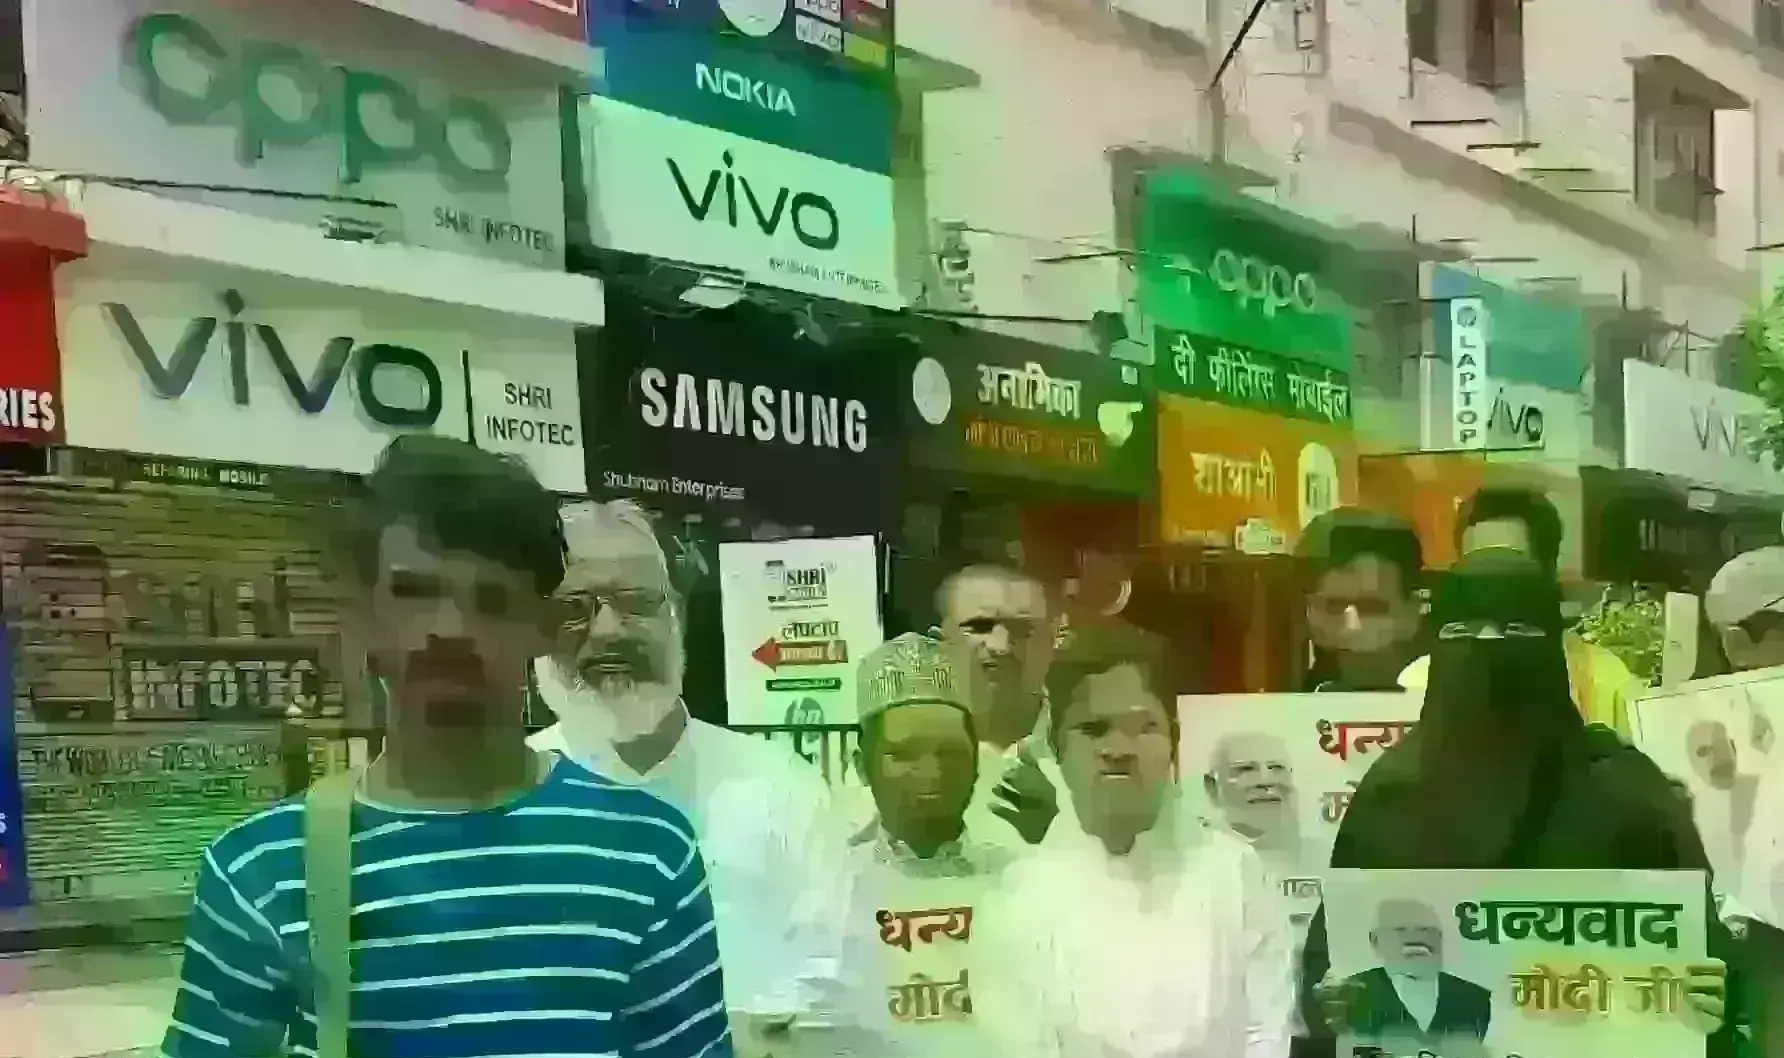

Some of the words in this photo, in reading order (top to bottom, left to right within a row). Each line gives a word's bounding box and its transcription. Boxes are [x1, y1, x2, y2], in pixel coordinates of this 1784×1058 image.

[696, 62, 796, 116] NOKIA
[667, 148, 841, 251] vivo
[102, 288, 443, 428] vivo
[504, 382, 553, 410] SHRI
[640, 367, 868, 453] SAMSUNG
[976, 361, 1082, 421] अनामिका
[1456, 335, 1477, 444] LAPTOP
[486, 415, 575, 448] INFOTEC
[1455, 901, 1684, 949] धन्यवाद
[1508, 963, 1612, 1014] मोदी
[1622, 963, 1688, 1014] जी
